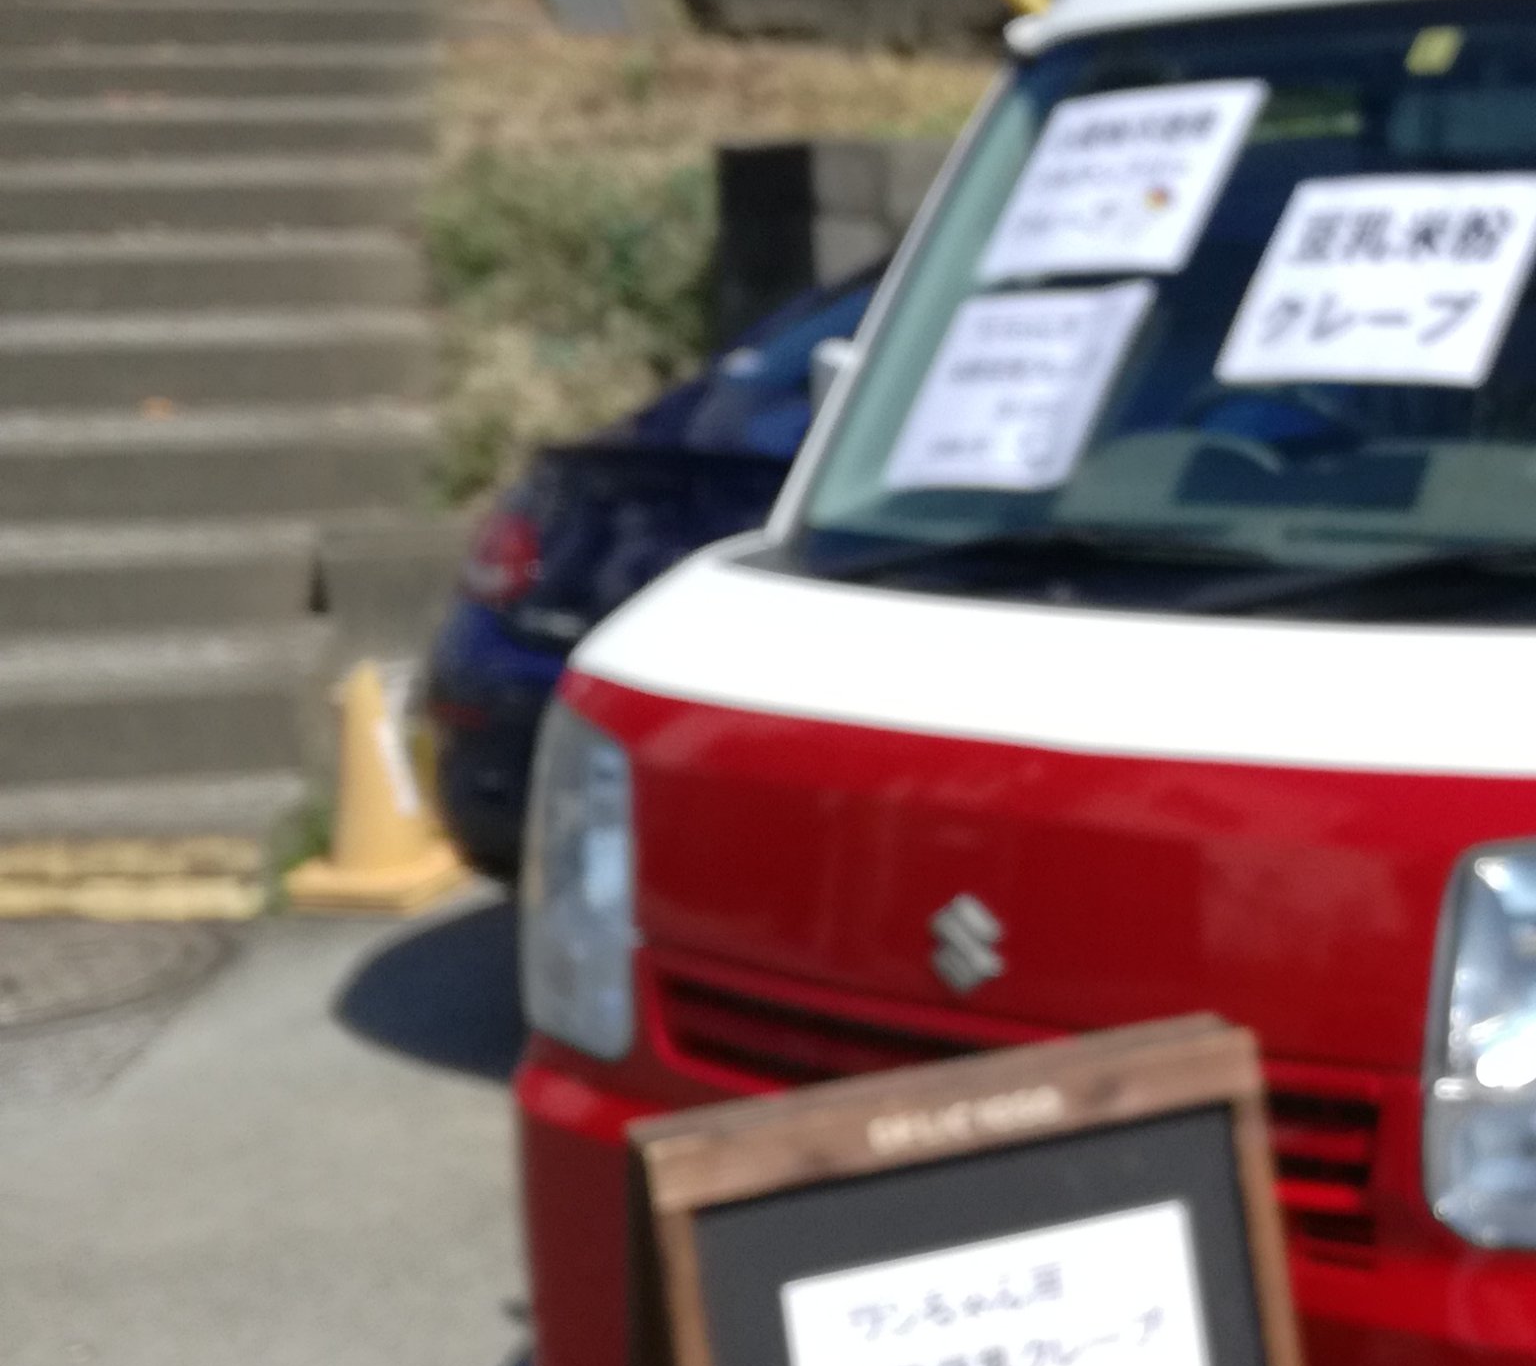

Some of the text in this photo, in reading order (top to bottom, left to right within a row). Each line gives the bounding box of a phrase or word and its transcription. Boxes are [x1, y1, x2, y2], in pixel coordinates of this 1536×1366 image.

[1290, 207, 1513, 266] 豆乳米粉
[1262, 292, 1478, 346] クレープ
